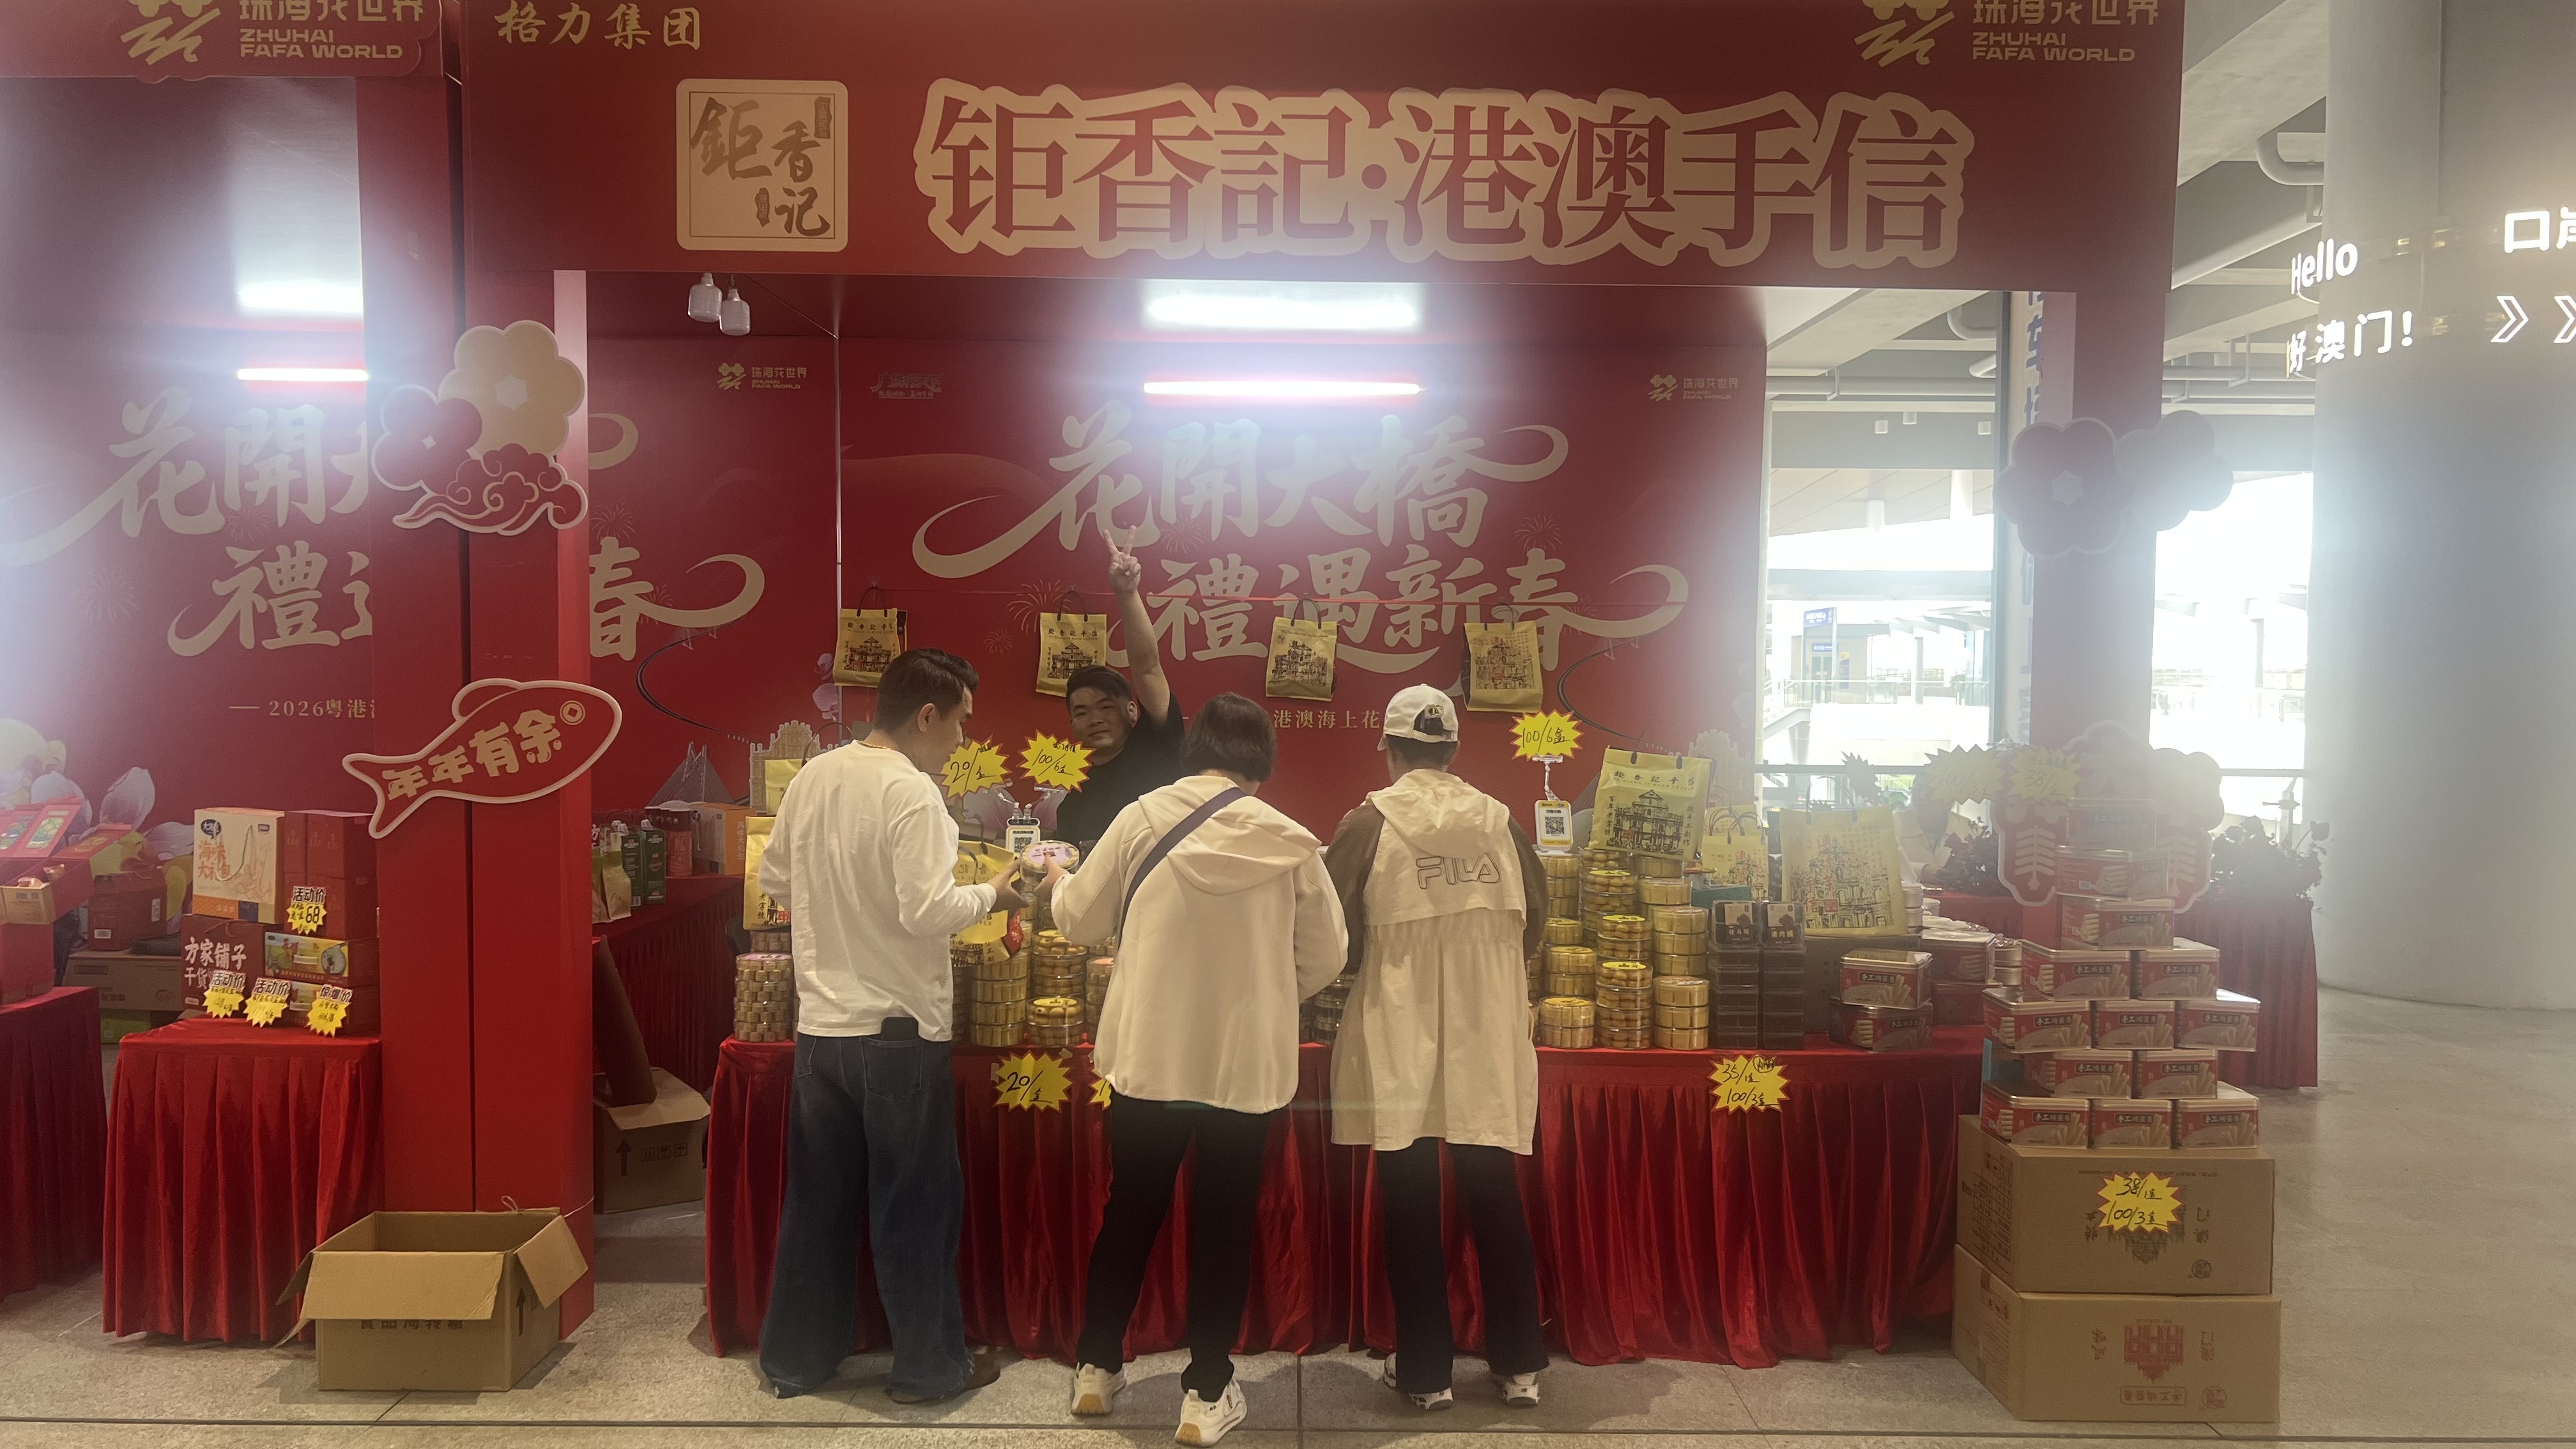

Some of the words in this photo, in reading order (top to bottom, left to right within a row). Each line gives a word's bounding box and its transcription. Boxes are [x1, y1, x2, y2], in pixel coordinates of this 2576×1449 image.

[240, 29, 334, 43] ZHUHAI
[494, 2, 702, 50] 格力集团
[1972, 32, 2066, 46] ZHUHAI
[240, 45, 310, 59] FAFA
[312, 45, 404, 59] WORLD
[1972, 48, 2036, 61] FAFA
[2044, 48, 2136, 62] WORLD
[2290, 238, 2358, 295] Hello
[912, 399, 1568, 579] 花開大橋
[1107, 544, 1689, 675] 禮遇新春
[269, 699, 374, 719] 2026粤港
[1273, 709, 1381, 729] 港澳海上花
[381, 709, 562, 801] 年年有余
[1416, 852, 1501, 890] FILA
[293, 887, 325, 903] 活动价
[305, 906, 320, 924] 68
[185, 936, 247, 970] 方家铺子
[211, 972, 245, 988] 活动价
[254, 979, 289, 996] 活动价
